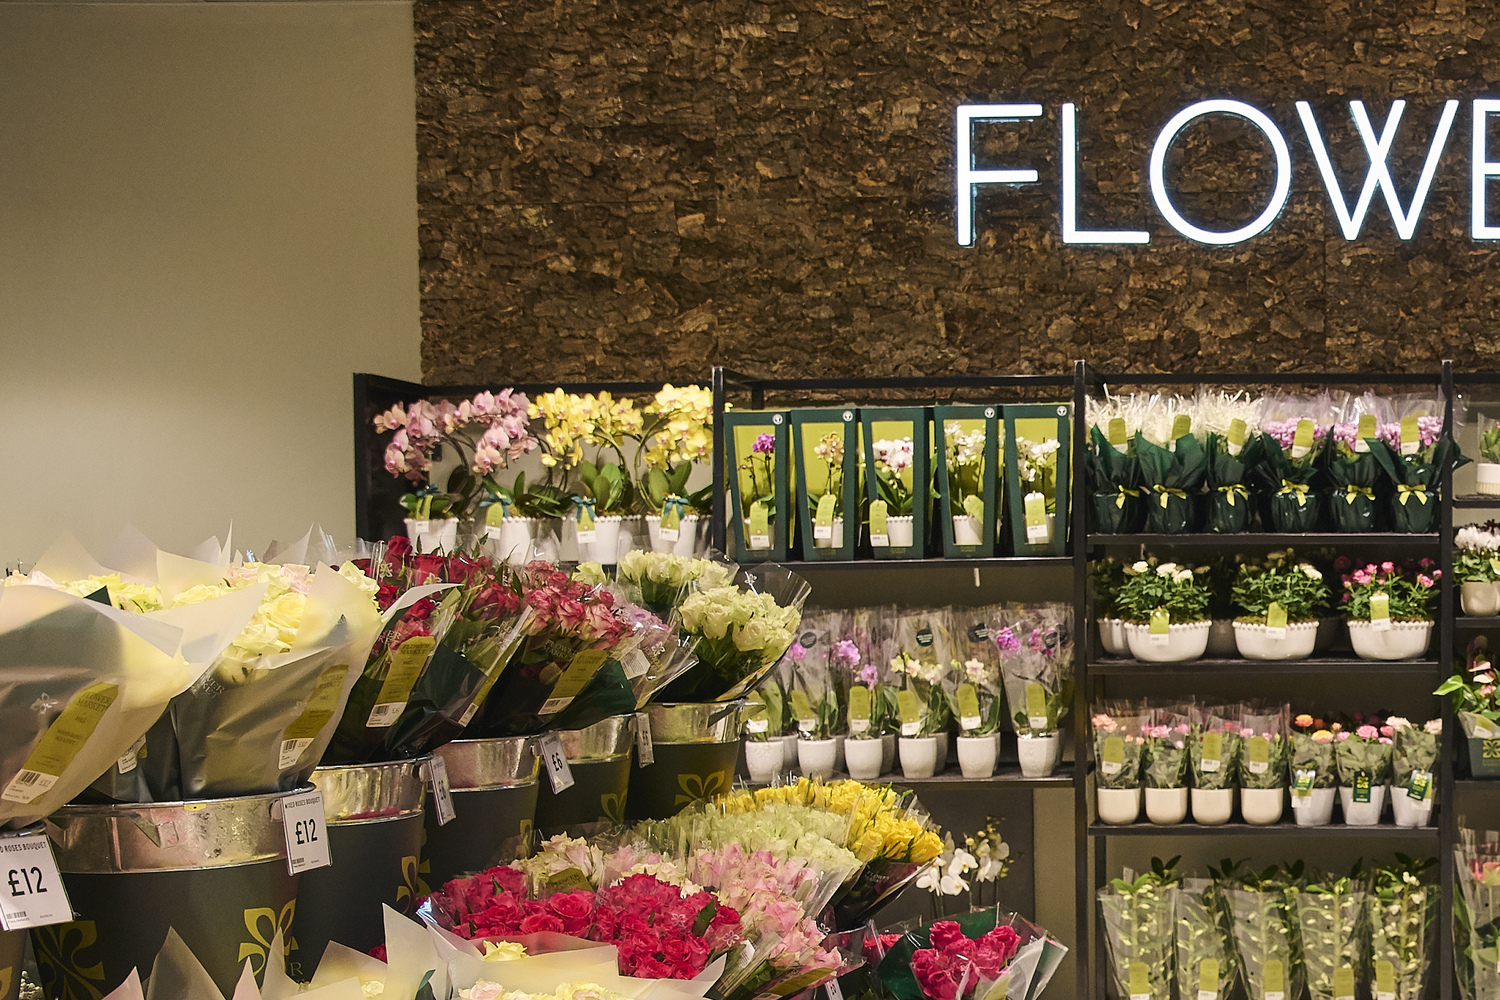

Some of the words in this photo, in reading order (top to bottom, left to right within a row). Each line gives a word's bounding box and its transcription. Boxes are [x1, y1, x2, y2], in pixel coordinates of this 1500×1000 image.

[551, 752, 563, 772] £6
[295, 818, 318, 845] £12
[5, 844, 22, 853] ROSES
[22, 841, 48, 851] BOUQUET
[7, 866, 48, 897] £12
